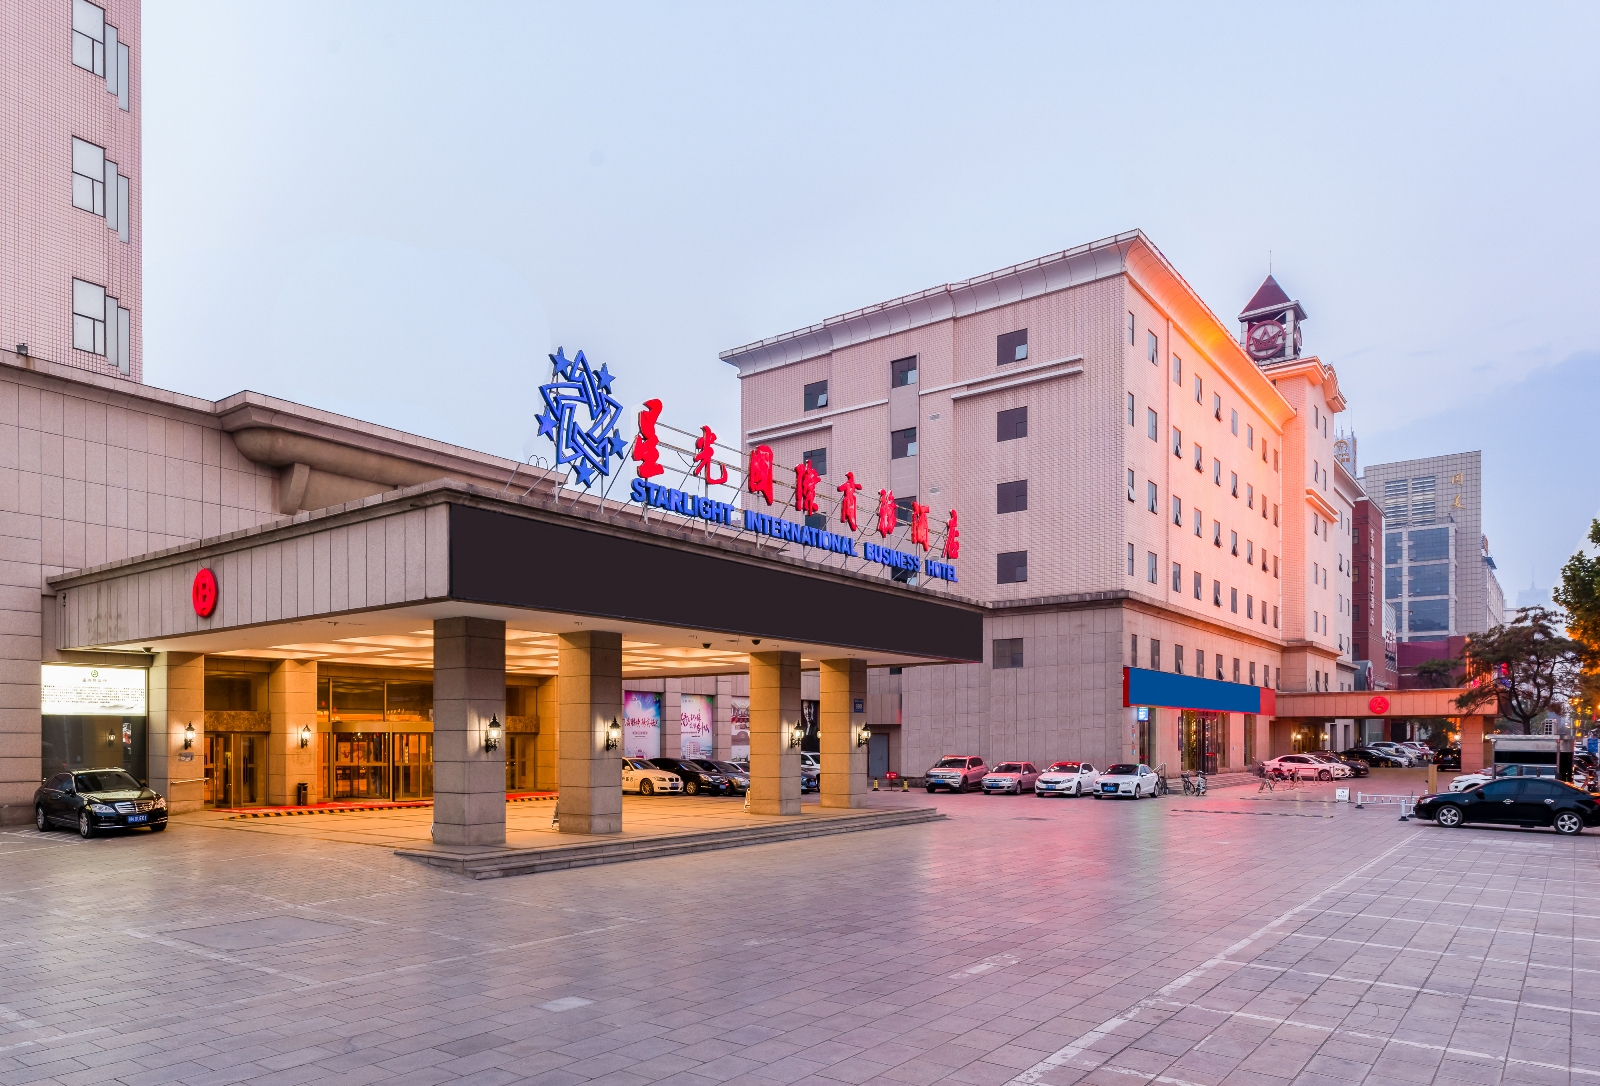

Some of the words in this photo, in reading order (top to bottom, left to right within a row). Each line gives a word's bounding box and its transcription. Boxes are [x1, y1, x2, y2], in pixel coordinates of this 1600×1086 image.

[630, 477, 734, 526] STARLIGHT
[744, 509, 858, 557] INTERNATIONAL
[864, 541, 920, 573] BUSINESS
[925, 559, 958, 583] HOTEL
